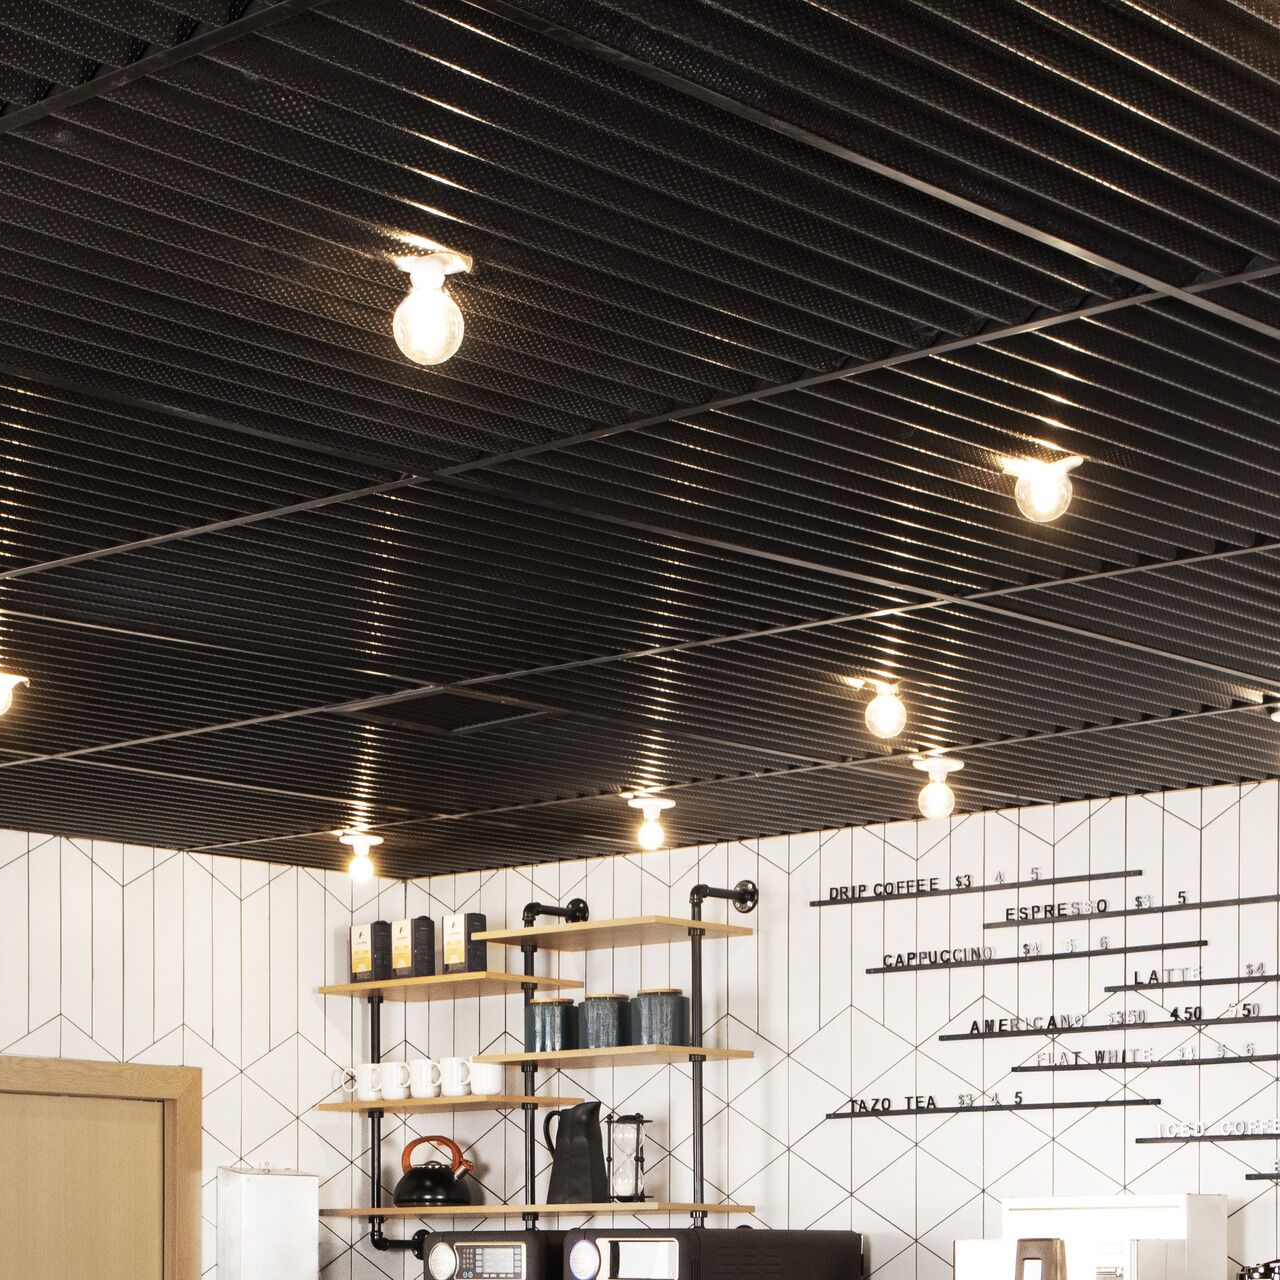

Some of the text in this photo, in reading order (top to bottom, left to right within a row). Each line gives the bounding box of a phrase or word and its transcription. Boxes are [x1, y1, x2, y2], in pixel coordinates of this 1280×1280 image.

[829, 867, 1042, 900] DRIP COFFEE $3 4 5
[1006, 891, 1188, 921] ESPRESSO $3 5
[884, 947, 995, 967] CAPPUCCINO
[1023, 943, 1042, 957] $4
[1100, 937, 1110, 950] 6
[1134, 967, 1202, 984] LATTE
[1246, 962, 1265, 976] $4
[970, 1014, 1085, 1034] AMERICANO
[1037, 1051, 1081, 1066] FLAT
[1094, 1048, 1153, 1064] WHITE
[1178, 1046, 1194, 1060] $4
[1246, 1042, 1256, 1056] 6
[850, 1098, 891, 1113] TAZO
[904, 1095, 937, 1110] TEA
[958, 1094, 973, 1107] $3
[1014, 1091, 1023, 1105] 5
[1158, 1121, 1206, 1138] ICED
